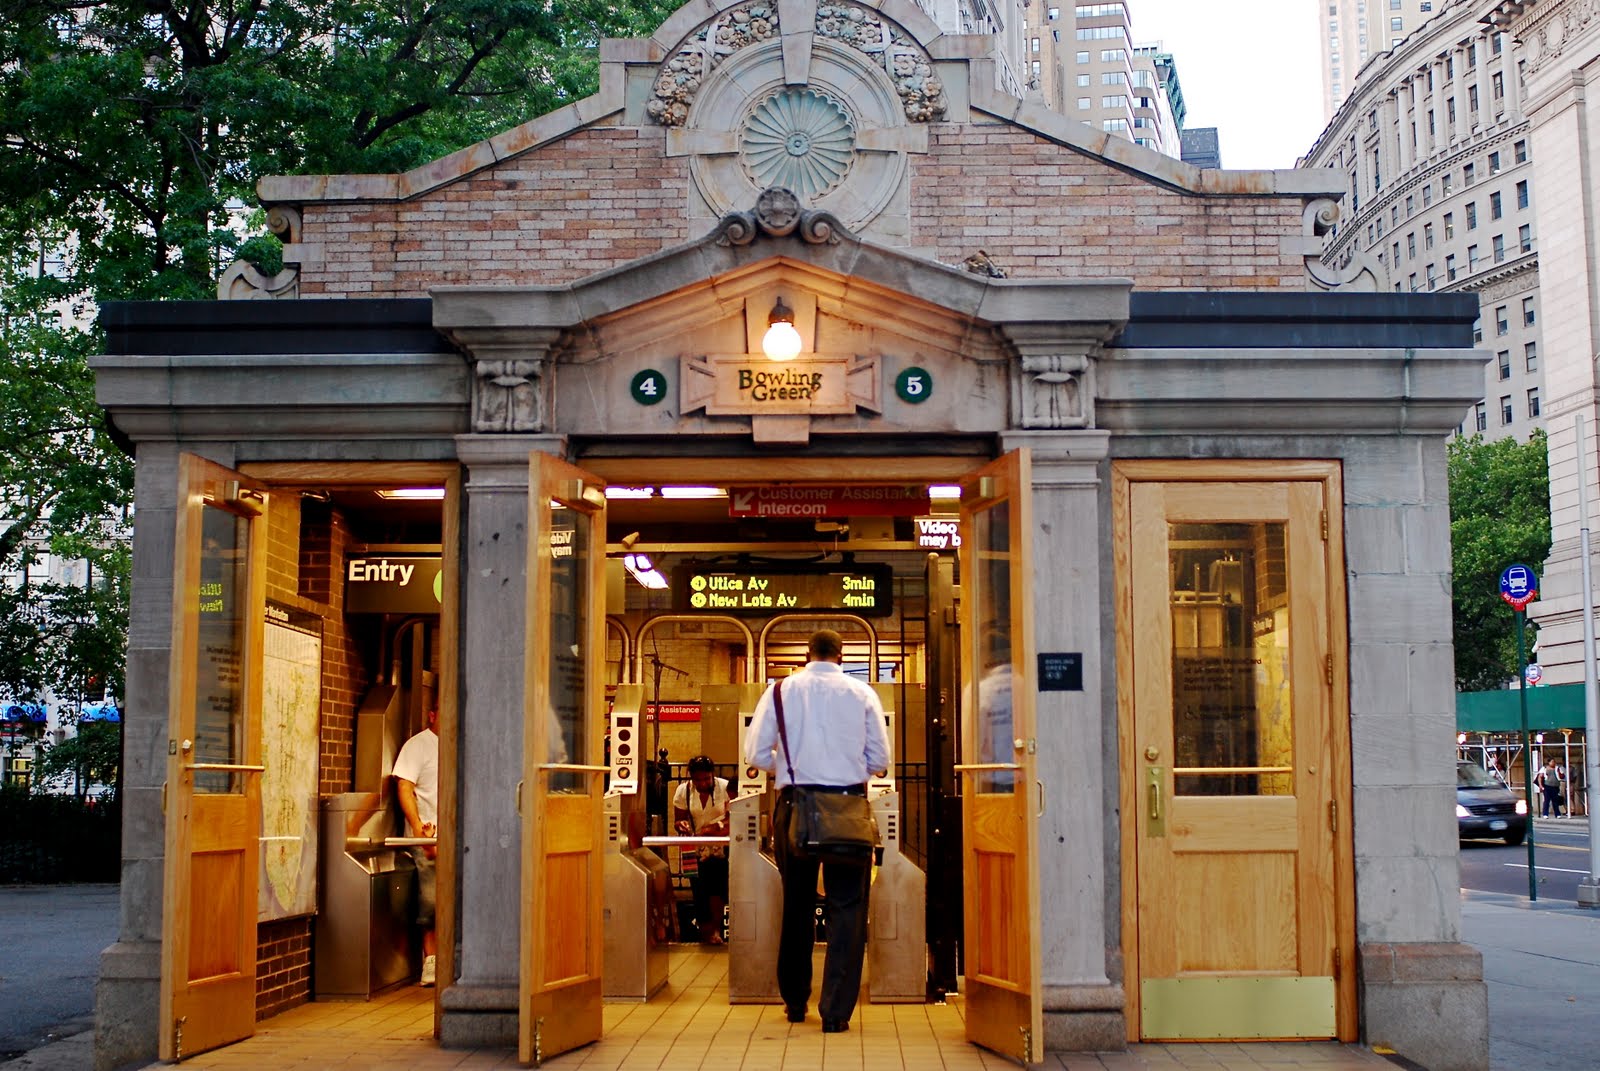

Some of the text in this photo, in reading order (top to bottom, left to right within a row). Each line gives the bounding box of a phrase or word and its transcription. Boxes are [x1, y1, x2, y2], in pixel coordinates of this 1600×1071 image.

[640, 377, 657, 396] 4
[738, 368, 822, 392] Bowling
[906, 376, 923, 395] 5
[752, 384, 812, 401] Green
[758, 486, 833, 500] Customer
[758, 502, 827, 515] Intercom
[919, 520, 957, 534] Video
[920, 535, 948, 548] may
[349, 560, 414, 586] Entry
[709, 577, 743, 590] Utica
[747, 577, 768, 590] Av
[842, 576, 875, 591] 3min
[709, 593, 738, 607] New
[742, 593, 772, 607] Lots
[776, 593, 797, 607] Av
[842, 593, 875, 607] 4min
[660, 706, 700, 714] Assistance
